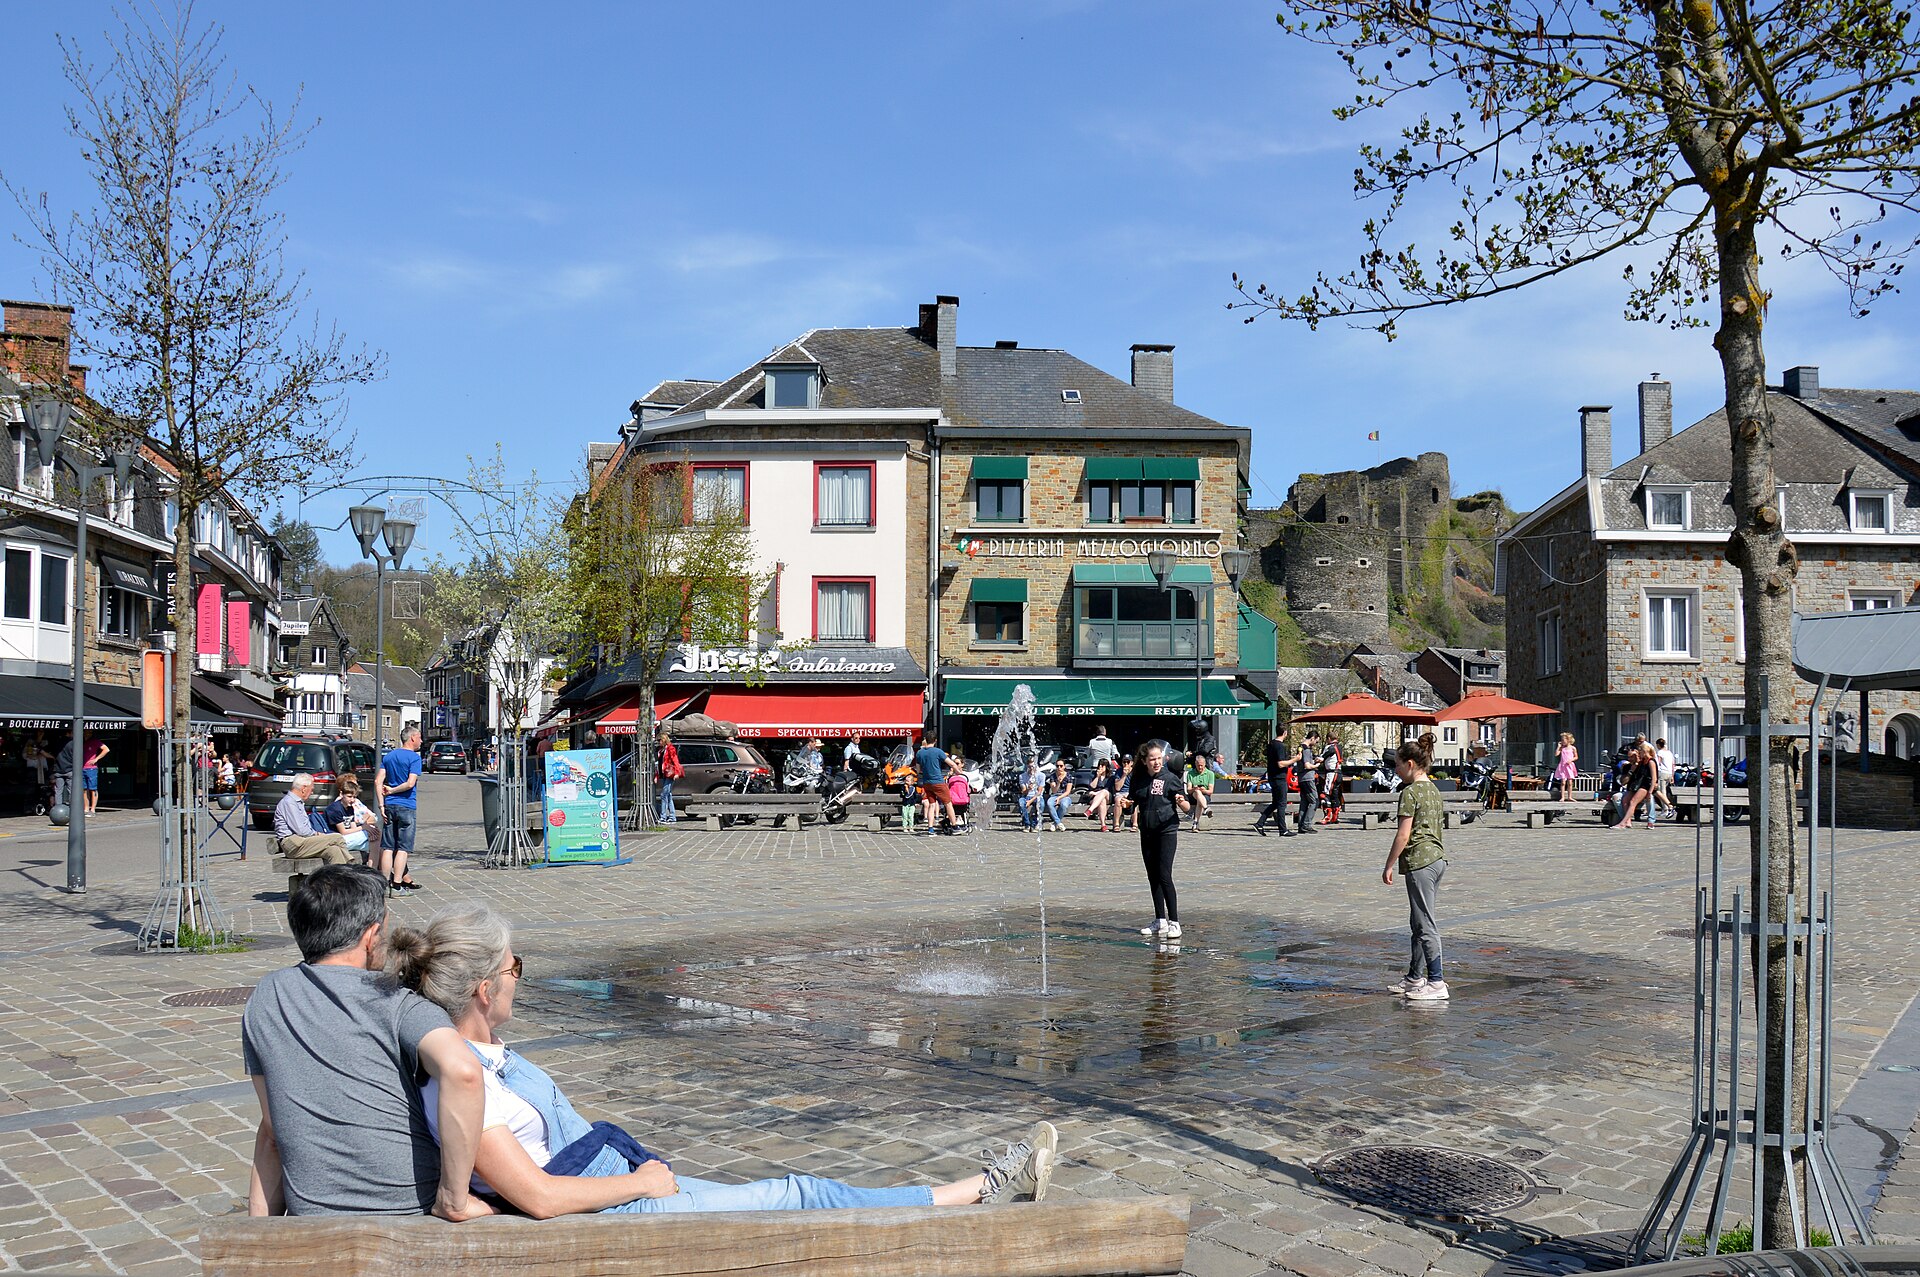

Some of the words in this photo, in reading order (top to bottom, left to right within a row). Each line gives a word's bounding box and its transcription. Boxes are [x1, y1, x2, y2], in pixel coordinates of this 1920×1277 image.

[989, 538, 1064, 556] PIZZERIA
[1076, 538, 1223, 557] MEZZOGIORNO
[669, 643, 780, 673] Josse
[786, 656, 896, 673] Salaisons
[949, 706, 984, 715] PIZZA
[1045, 706, 1061, 715] DE
[1068, 706, 1095, 715] BOIS
[1155, 707, 1240, 716] RESTAURANT
[9, 719, 60, 729] BOUCHERIE
[83, 721, 127, 730] ARCUTERIE
[604, 725, 637, 734] BOUCHE
[777, 728, 841, 737] SPECIALITES
[845, 728, 912, 737] ARTISANALES
